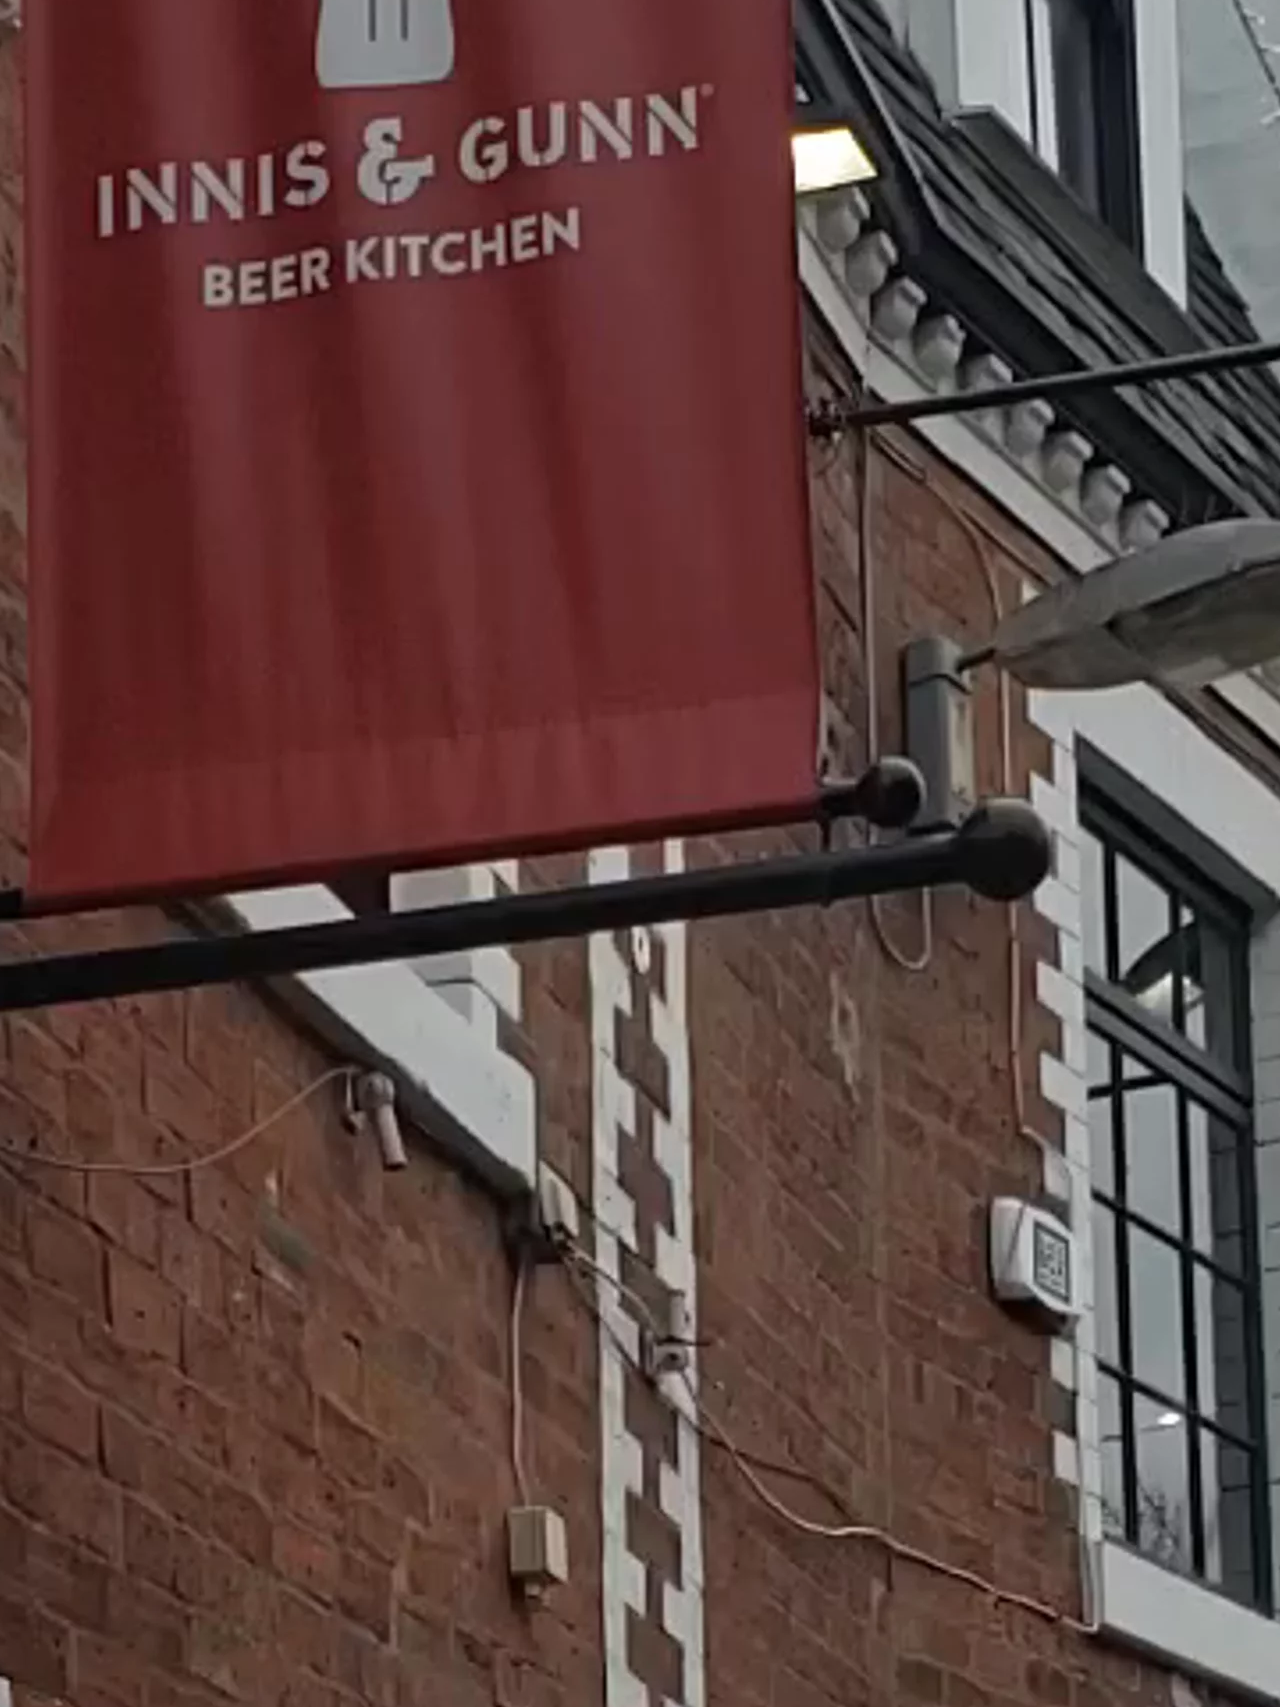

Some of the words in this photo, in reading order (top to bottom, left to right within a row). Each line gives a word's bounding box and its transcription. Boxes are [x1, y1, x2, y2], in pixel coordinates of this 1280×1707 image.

[96, 139, 330, 238] INNIS
[356, 116, 435, 205] &
[459, 85, 702, 182] GUNN
[202, 245, 331, 309] BEER
[345, 206, 582, 284] KITCHEN
